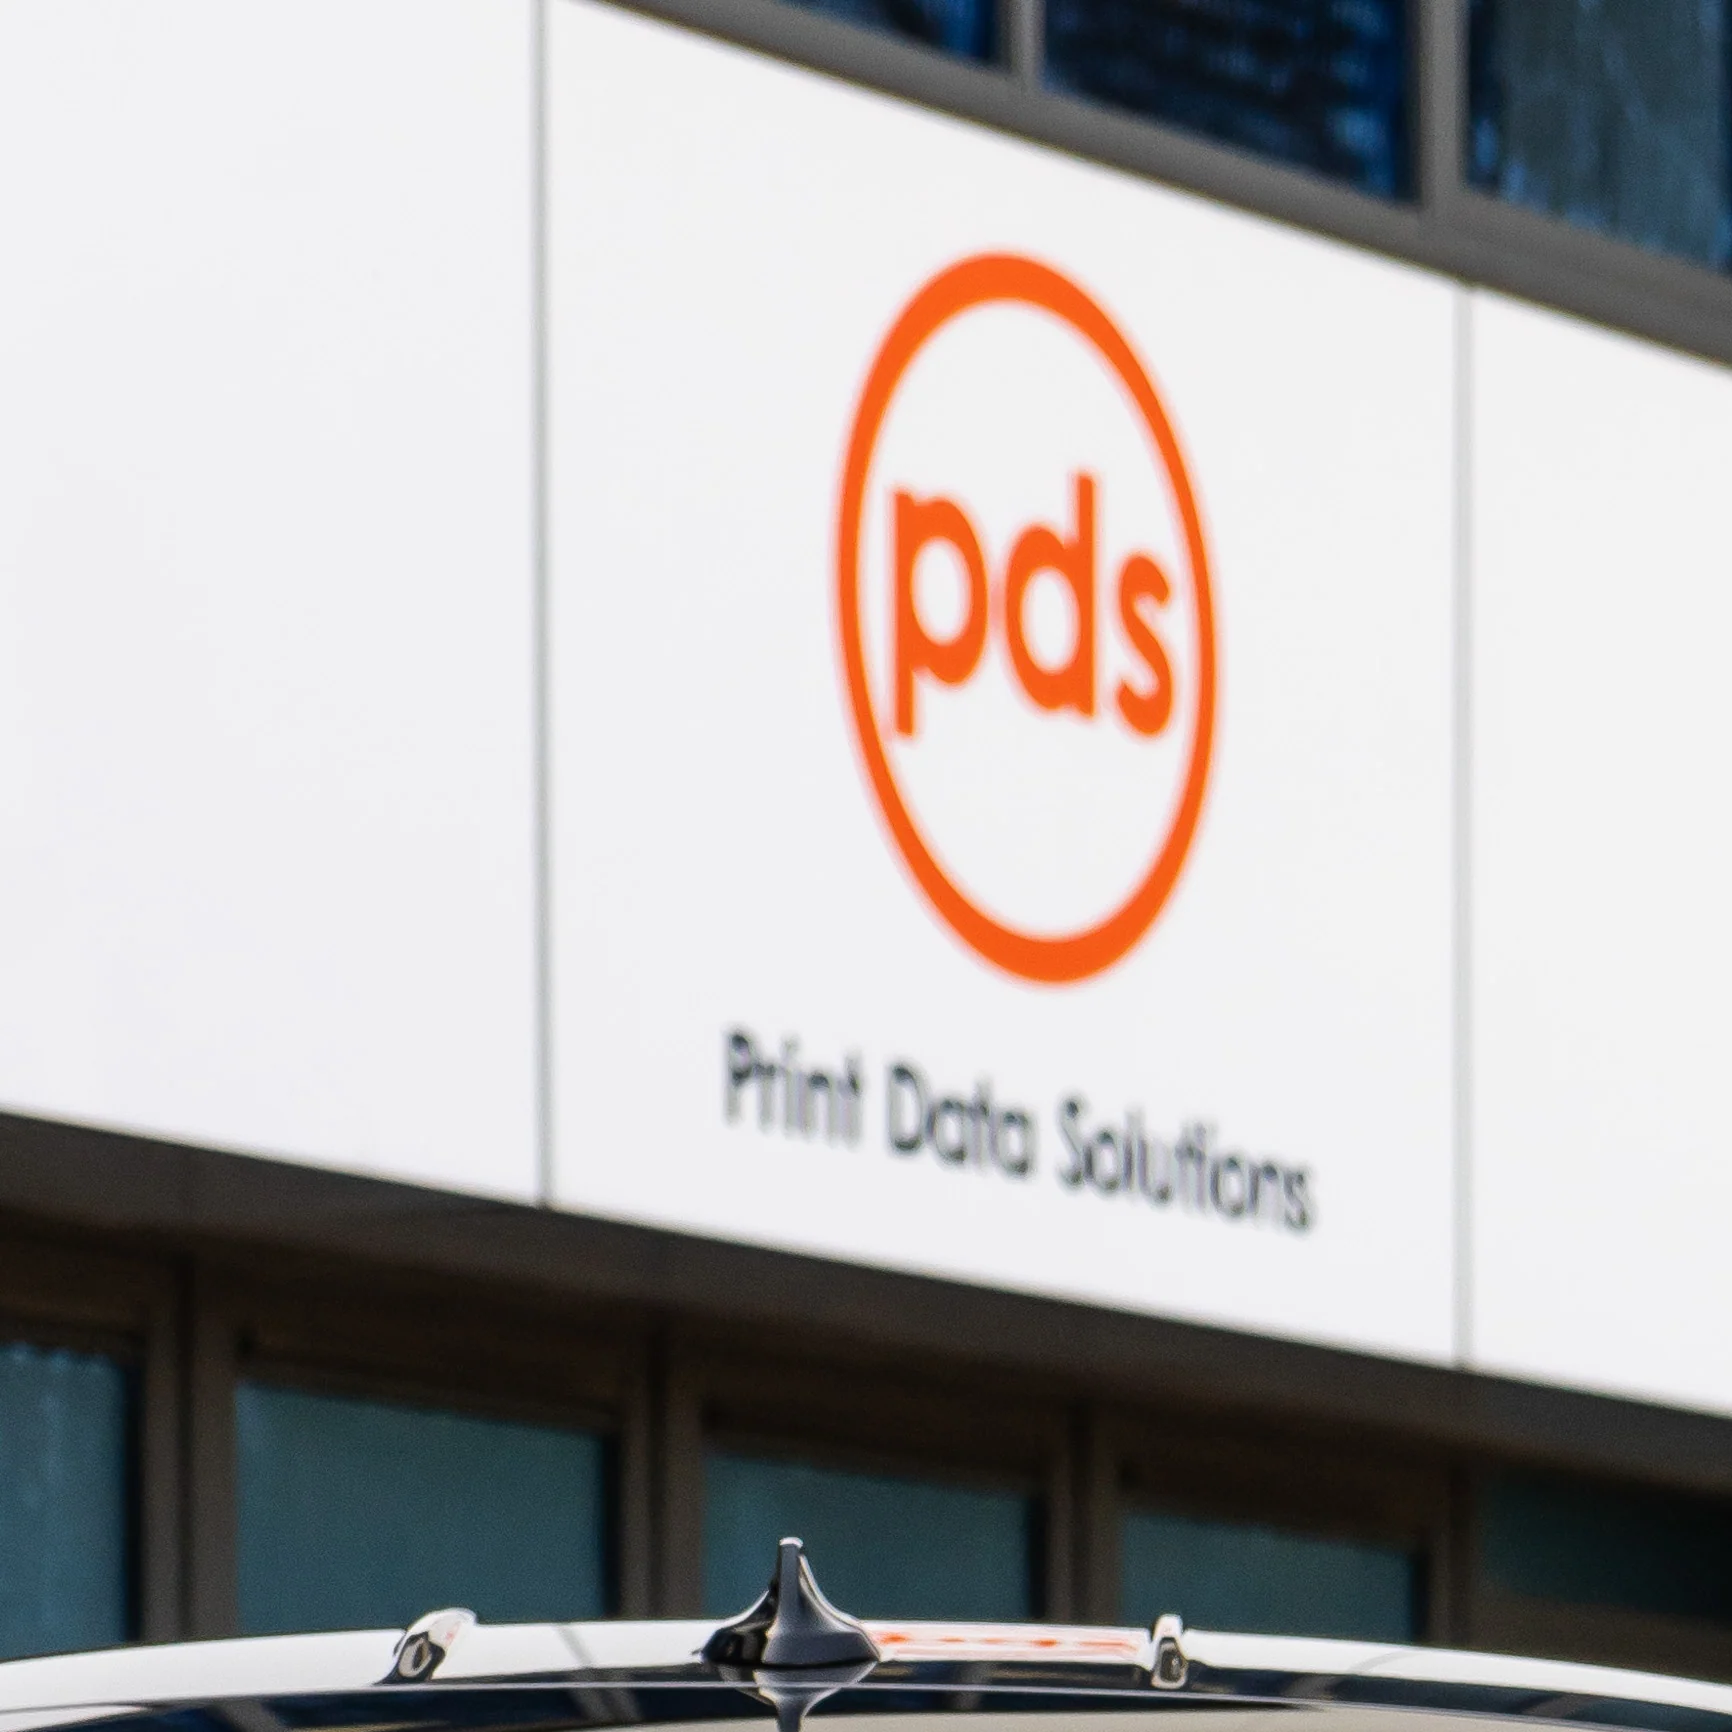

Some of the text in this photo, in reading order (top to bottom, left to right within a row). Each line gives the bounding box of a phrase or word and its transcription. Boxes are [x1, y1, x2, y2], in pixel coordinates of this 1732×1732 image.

[890, 472, 1176, 738] pds
[722, 1030, 1316, 1234] Print Data Solutions
